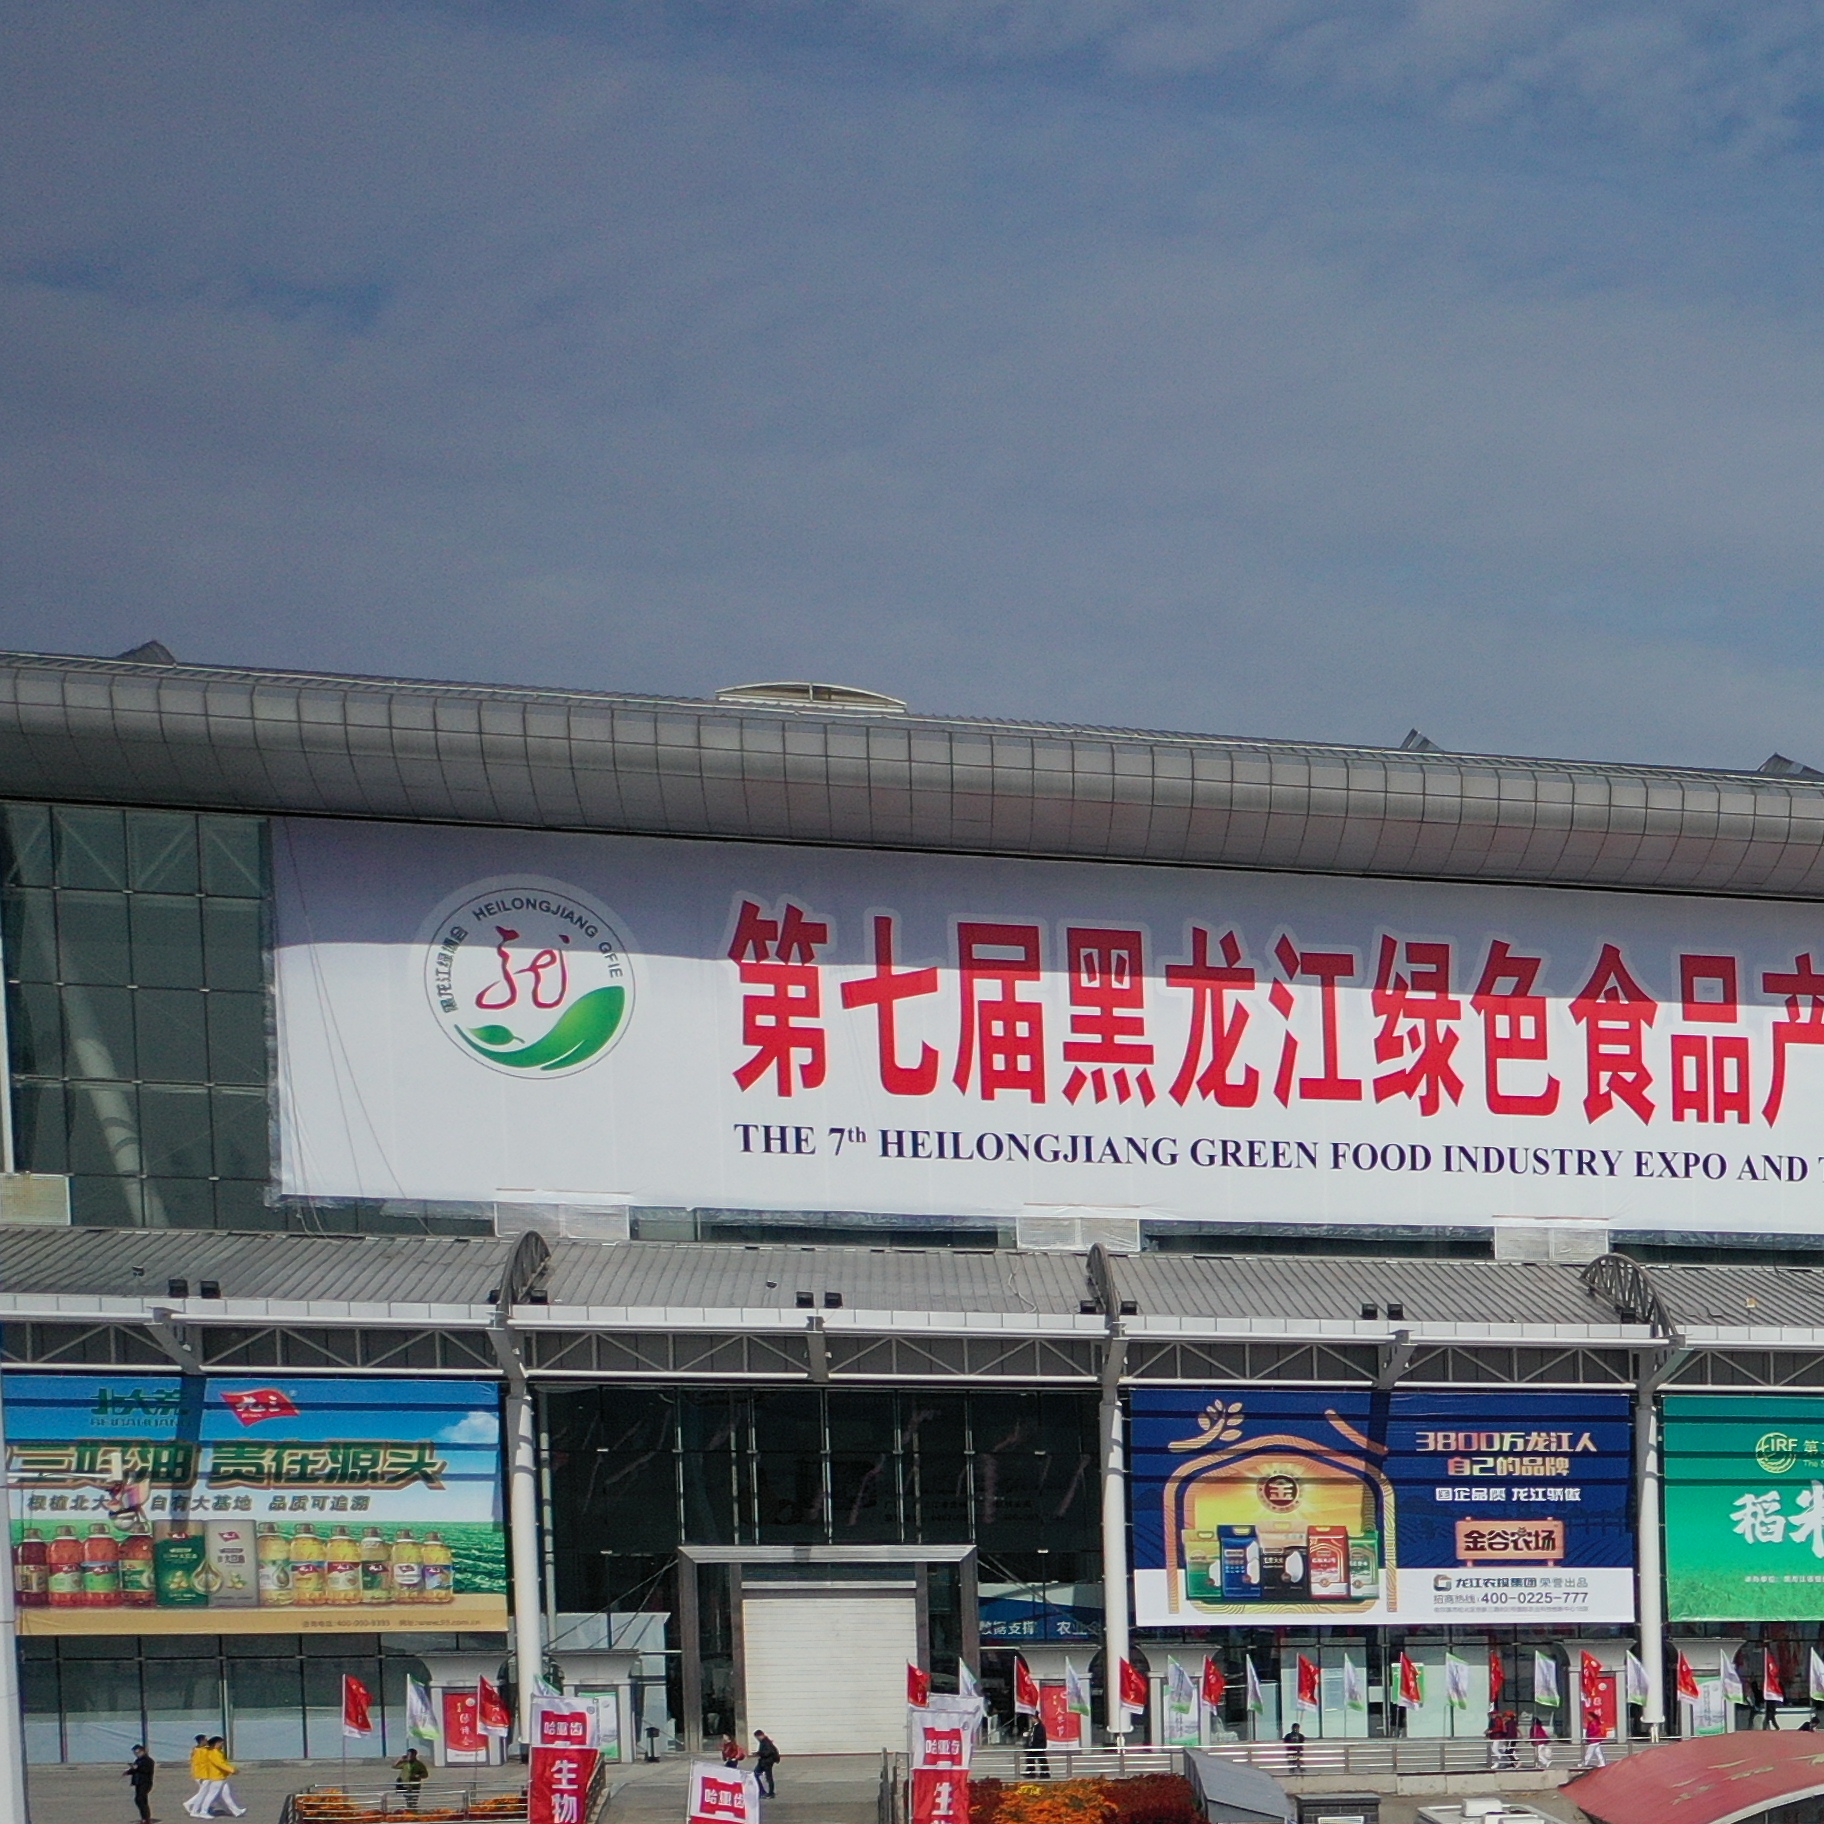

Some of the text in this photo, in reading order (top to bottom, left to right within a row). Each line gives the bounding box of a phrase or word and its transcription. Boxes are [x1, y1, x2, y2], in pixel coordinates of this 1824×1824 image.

[472, 898, 623, 978] HEILONGJIANG GFIE
[734, 1124, 815, 1155] THE
[827, 1126, 867, 1158] 7th
[879, 1128, 1178, 1167] HEILONGJIANG
[1191, 1138, 1318, 1170] GREEN
[1331, 1142, 1431, 1174] FOOD
[1444, 1144, 1623, 1178] INDUSTRY
[1634, 1150, 1727, 1180] EXPO
[1737, 1154, 1808, 1183] AND
[1415, 1431, 1598, 1452] 3800万龙江人
[1770, 1438, 1798, 1451] IRF
[212, 1441, 438, 1485] 责任源头
[1447, 1456, 1570, 1477] 自己的品牌
[1803, 1459, 1817, 1468] The
[151, 1494, 252, 1511] 自有大基地
[269, 1494, 370, 1511] 品质可追溯
[1435, 1487, 1581, 1501] 国企品质 龙江骄傲
[1463, 1527, 1556, 1551] 金谷农场
[1481, 1591, 1589, 1604] 400-0225-777
